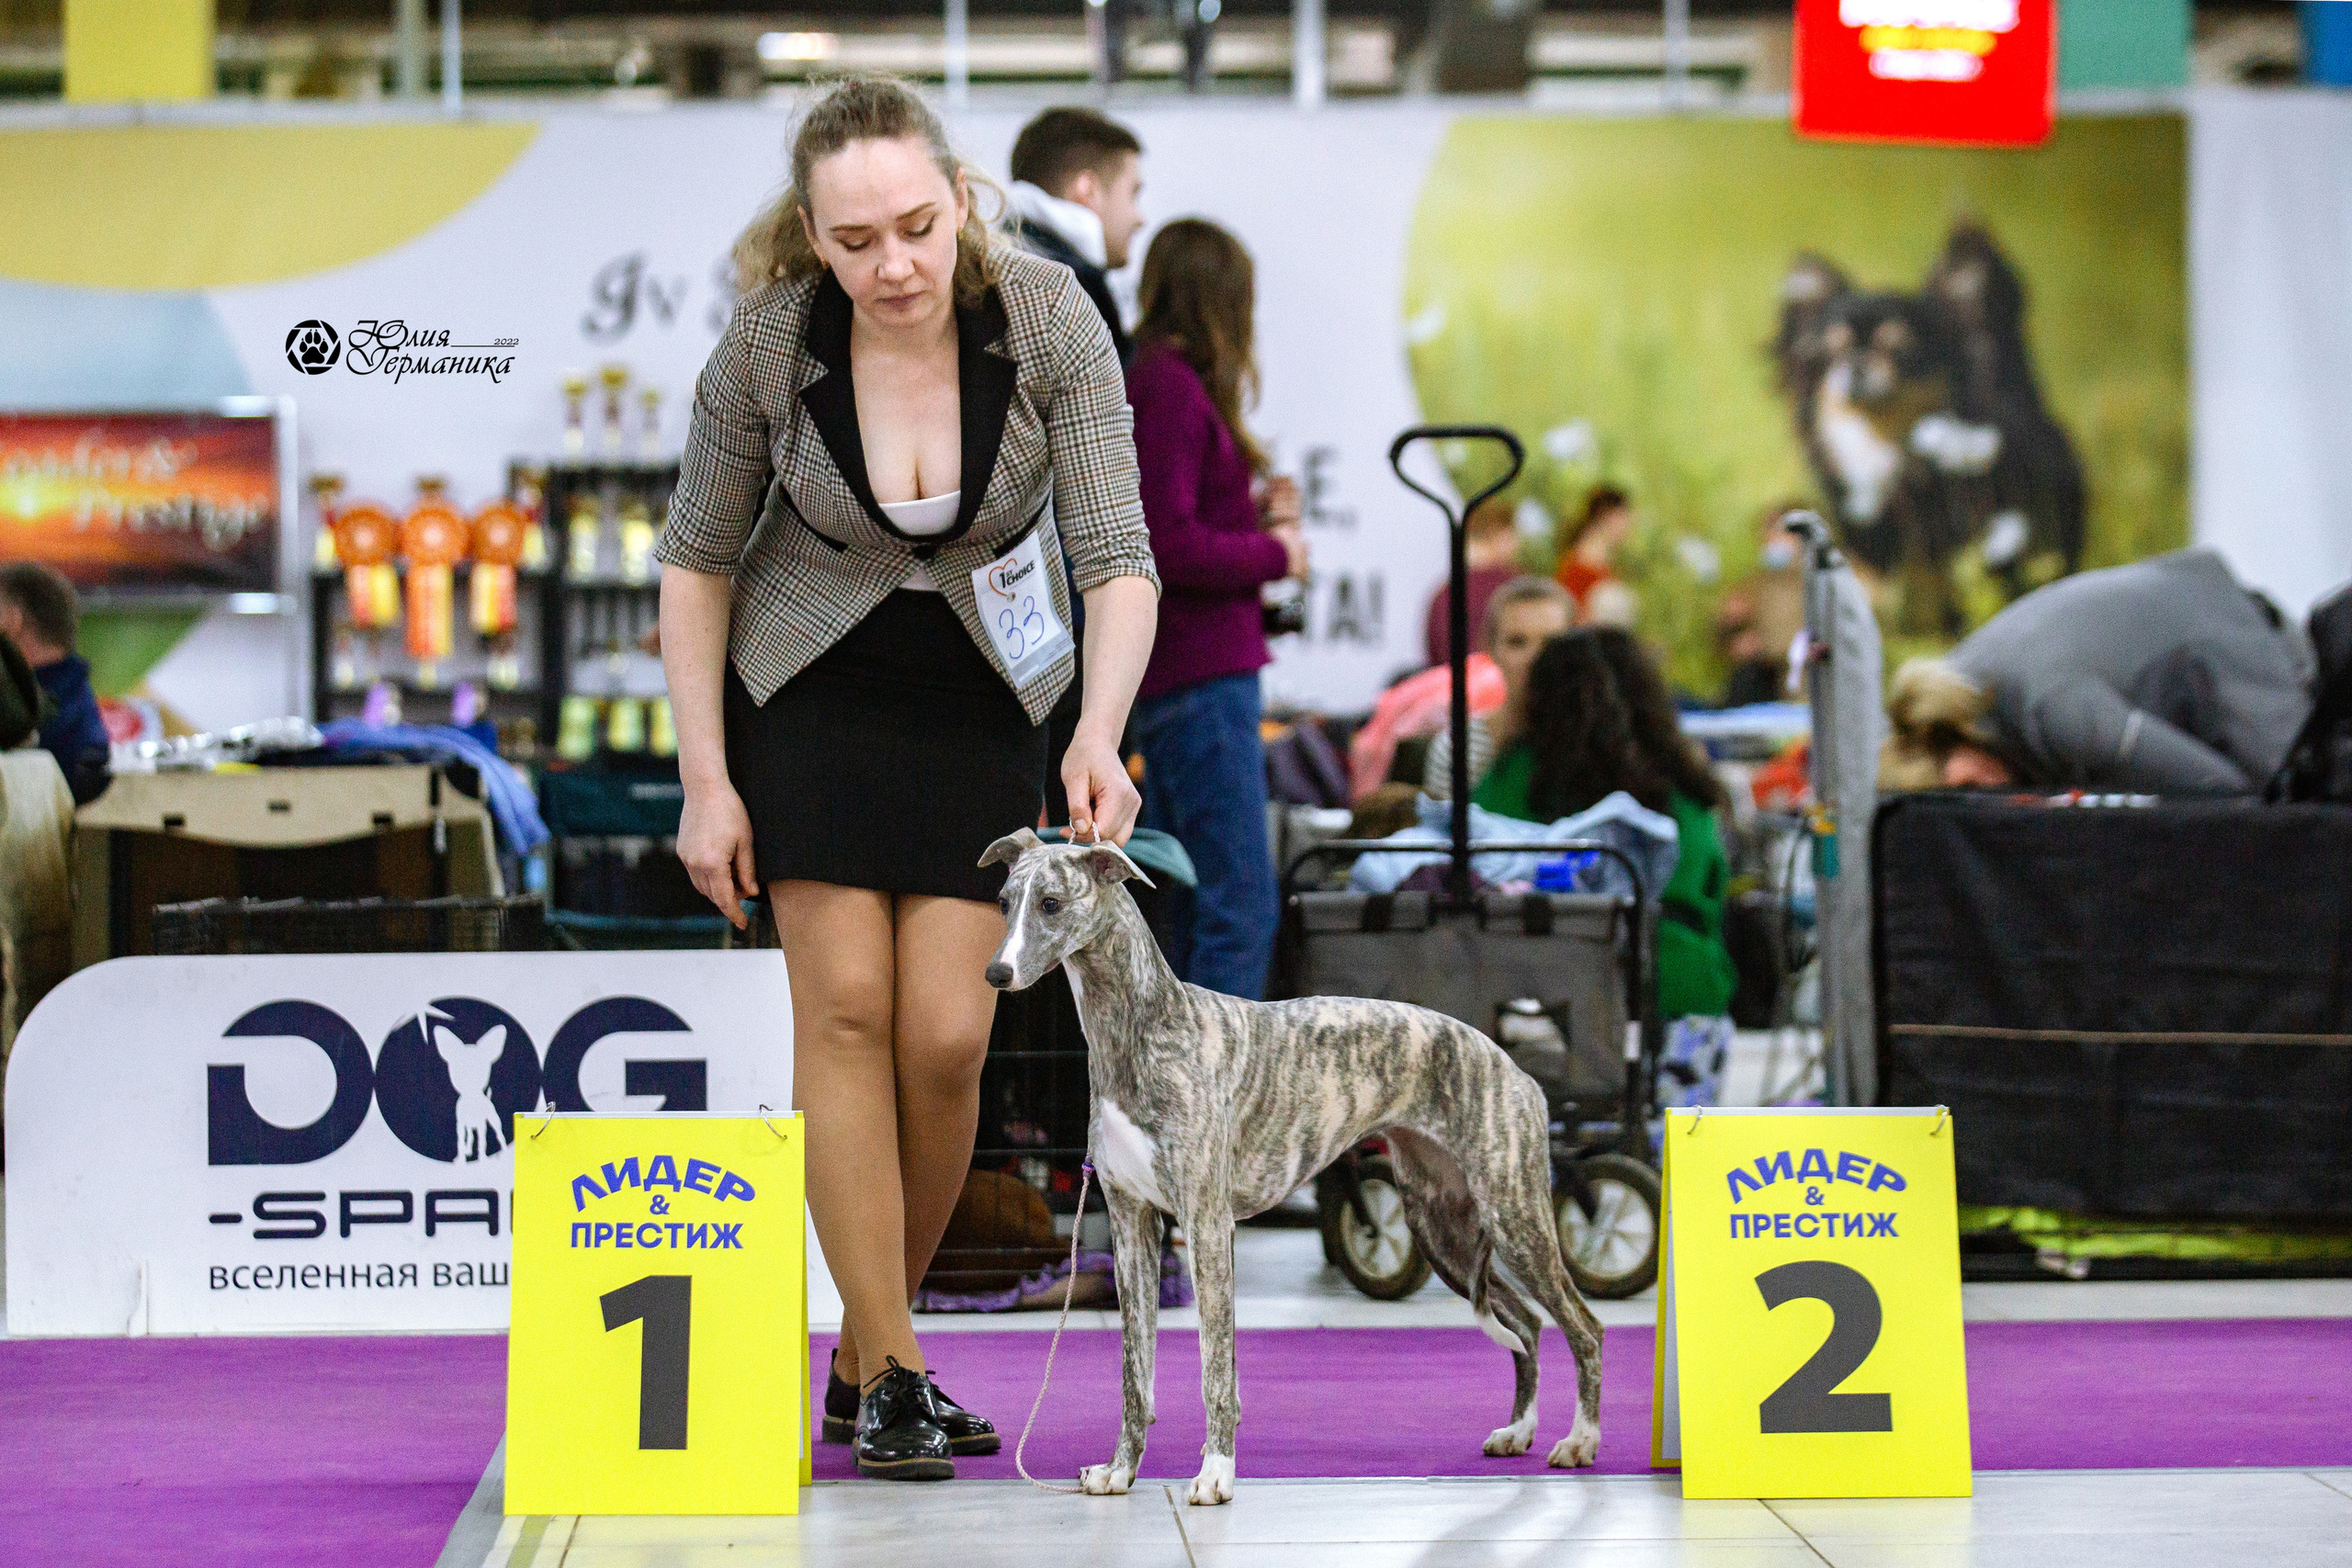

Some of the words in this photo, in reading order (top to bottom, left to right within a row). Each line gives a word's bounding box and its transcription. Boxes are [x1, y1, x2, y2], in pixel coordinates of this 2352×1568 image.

[1006, 559, 1035, 586] CHOICE
[999, 595, 1045, 660] 33
[207, 994, 707, 1166] DOG
[571, 1155, 756, 1213] ЛИДЕР
[1726, 1148, 1907, 1205] ЛИДЕР
[1804, 1185, 1826, 1206] &
[209, 1188, 514, 1239] -SPA
[649, 1193, 671, 1215] &
[1729, 1213, 1900, 1238] ПРЕСТИЖ
[571, 1222, 744, 1249] ПРЕСТИЖ
[209, 1262, 419, 1290] вселенная
[599, 1274, 693, 1450] 1
[1754, 1259, 1894, 1434] 2
